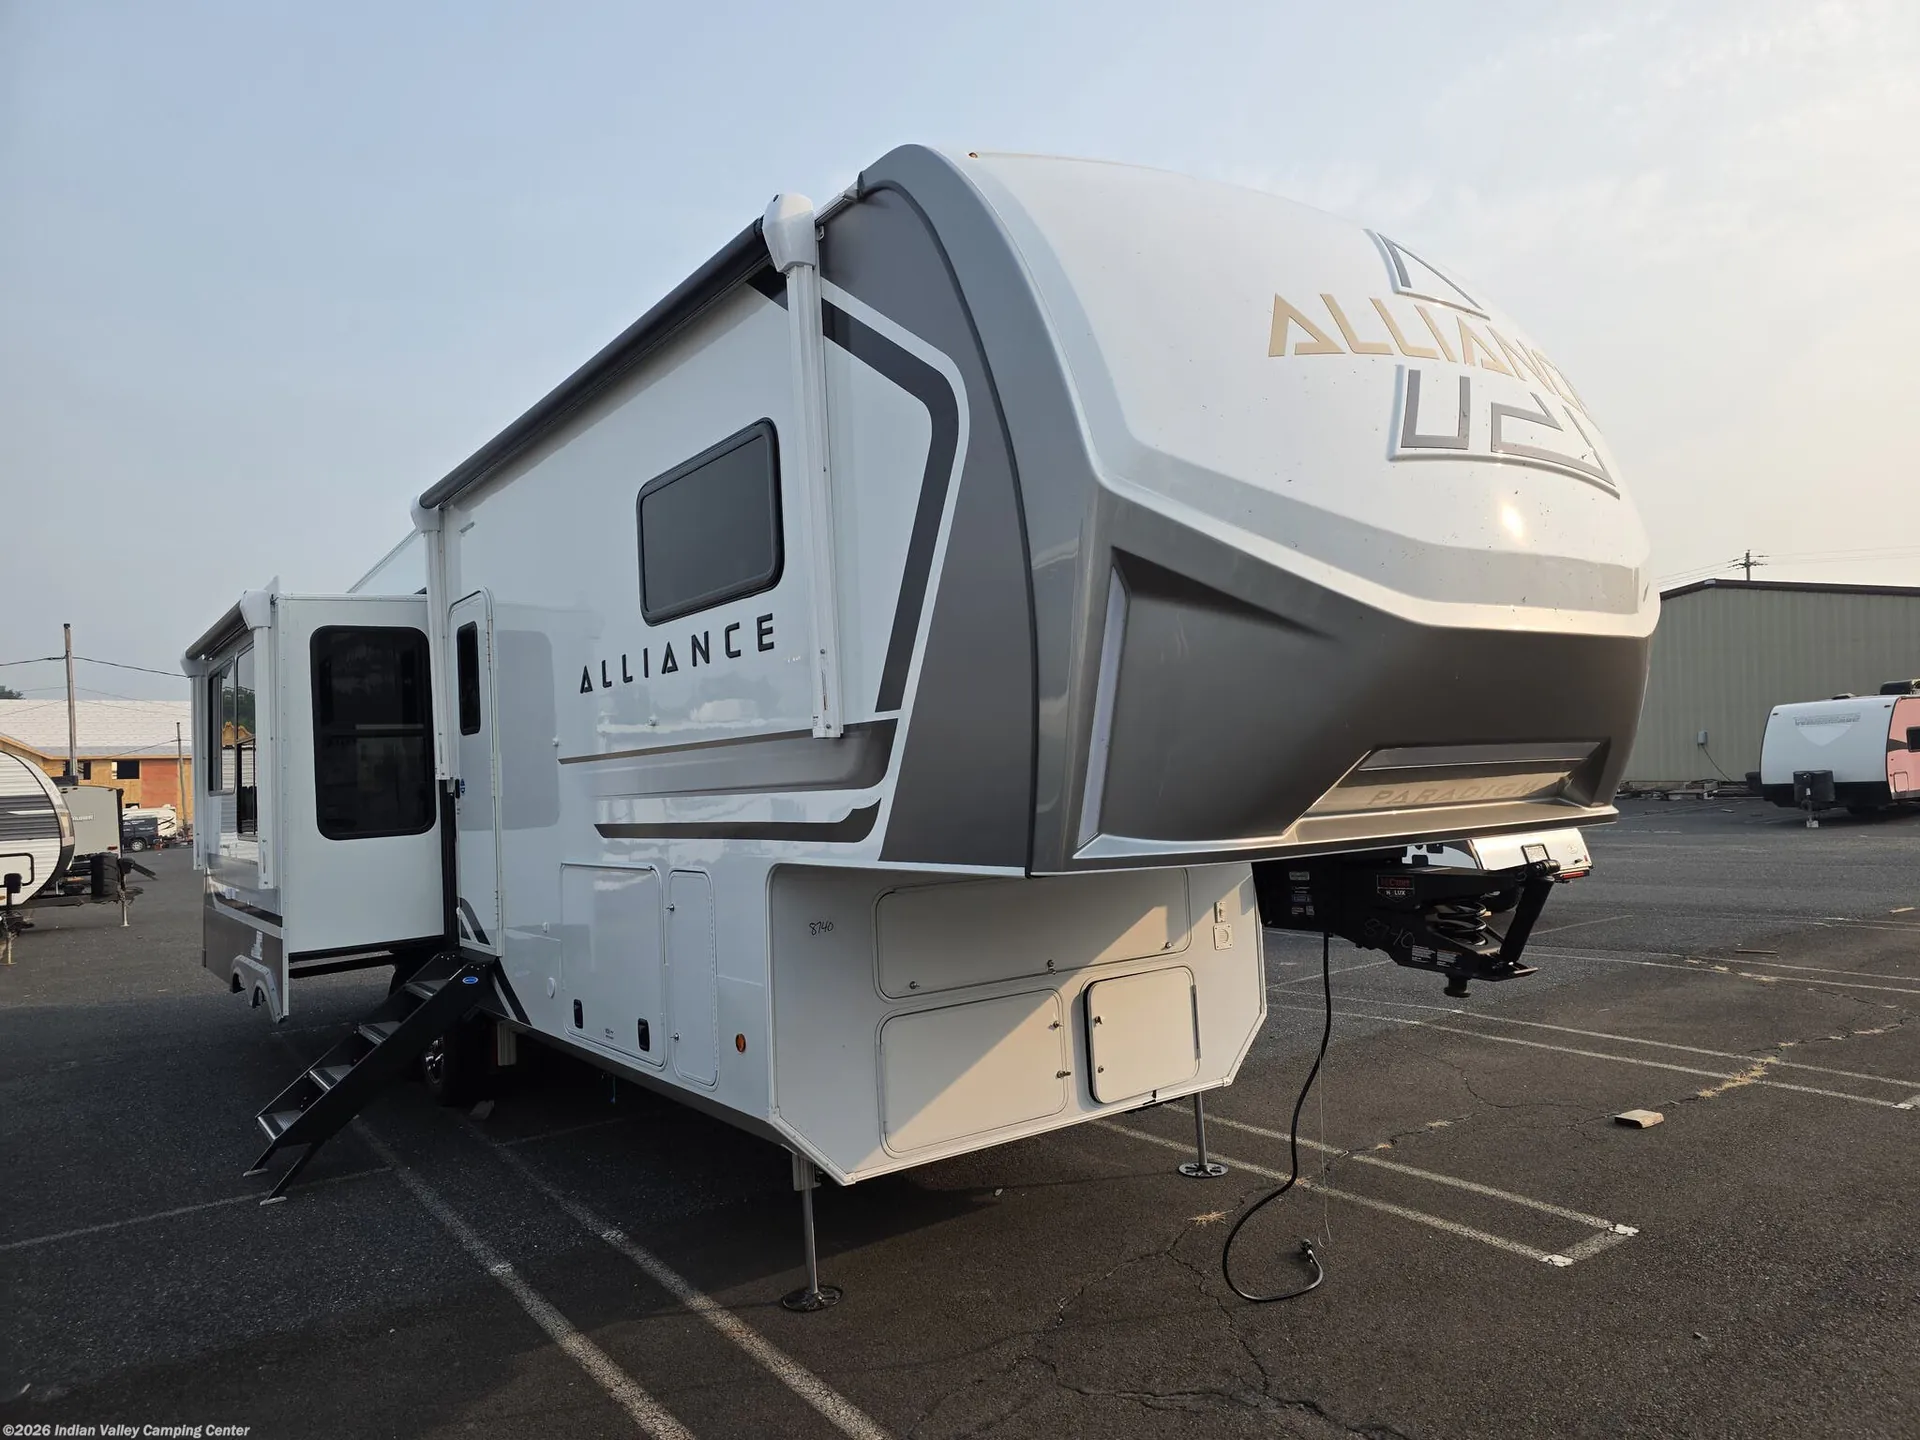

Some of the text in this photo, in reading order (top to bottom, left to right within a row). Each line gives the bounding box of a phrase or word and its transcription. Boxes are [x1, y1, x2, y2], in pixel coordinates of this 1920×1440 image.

[580, 612, 775, 694] ALLIANCE
[1366, 780, 1540, 808] PARADIGM
[809, 920, 834, 936] 8740
